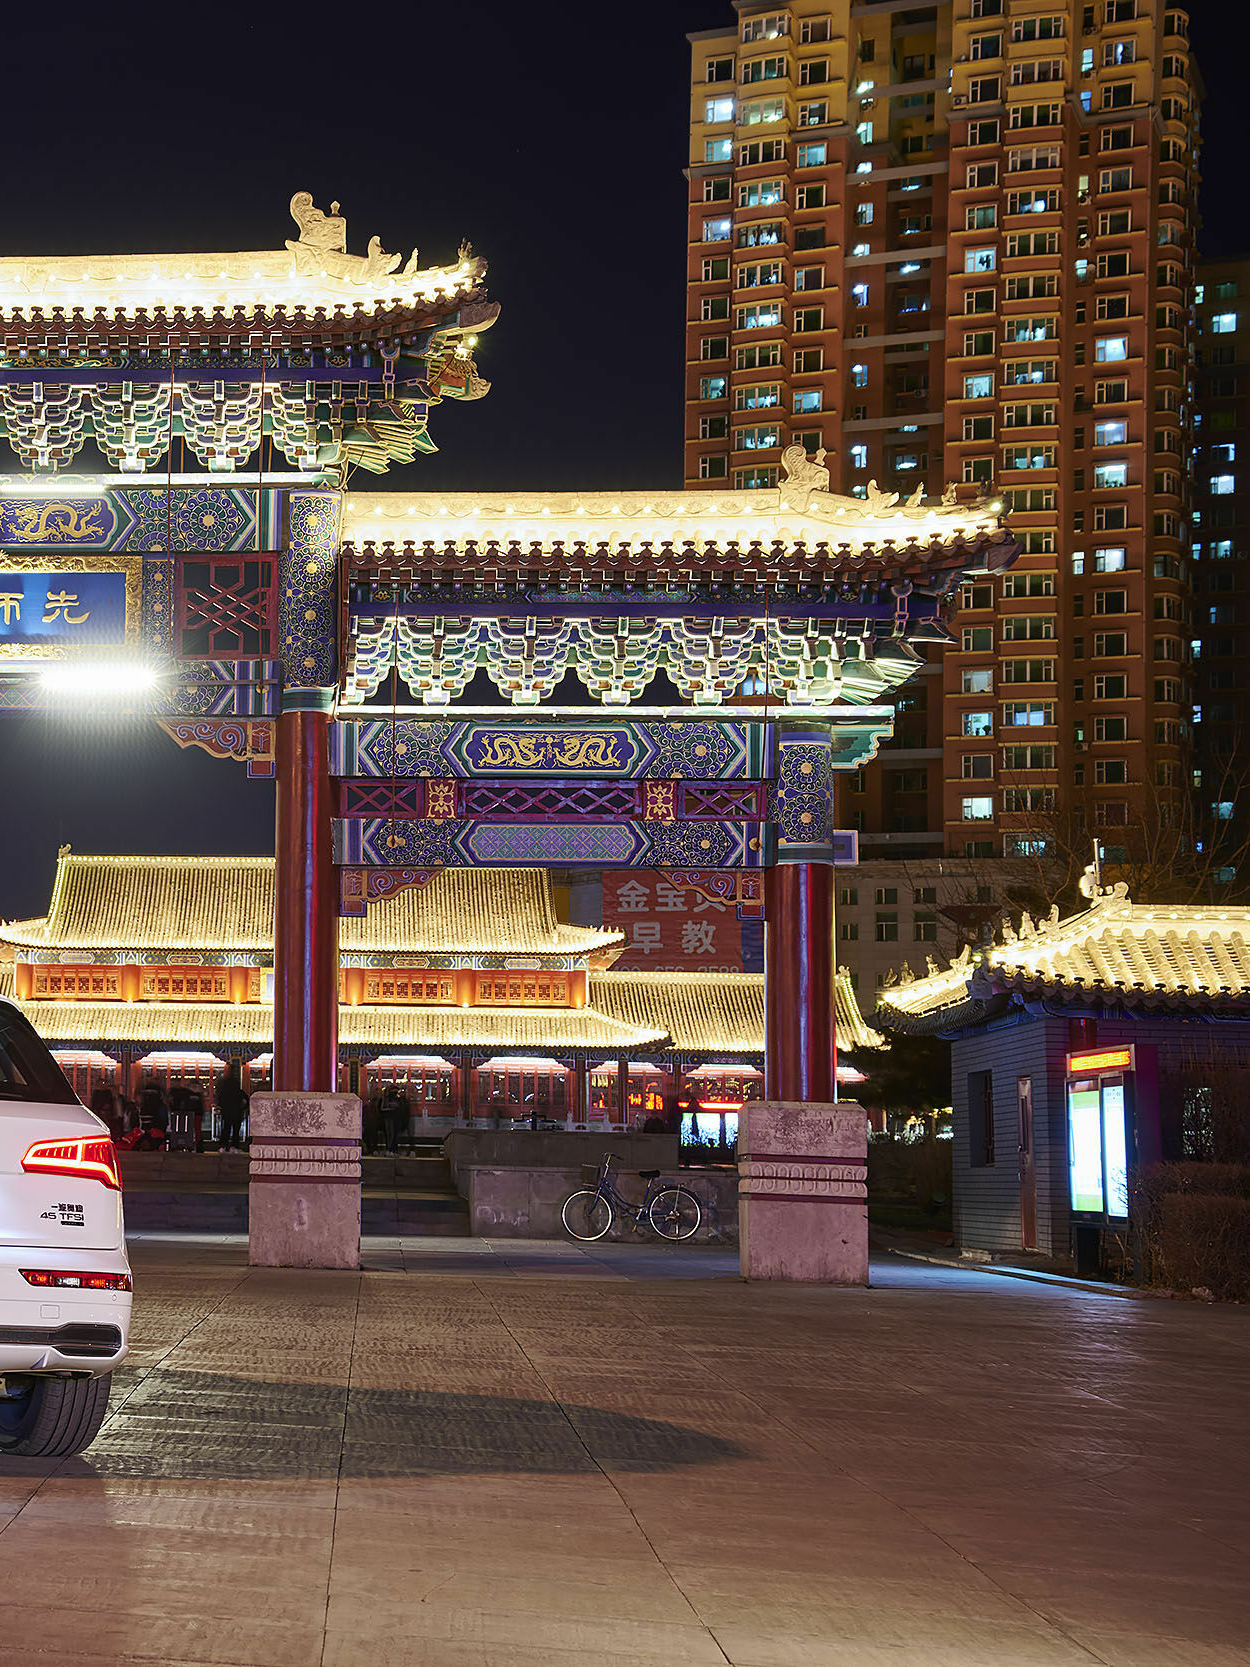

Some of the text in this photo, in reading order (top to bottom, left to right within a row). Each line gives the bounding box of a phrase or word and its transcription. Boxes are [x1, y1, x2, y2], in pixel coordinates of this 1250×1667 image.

[630, 920, 717, 954] 早教
[40, 1211, 84, 1221] 45 TFSI
